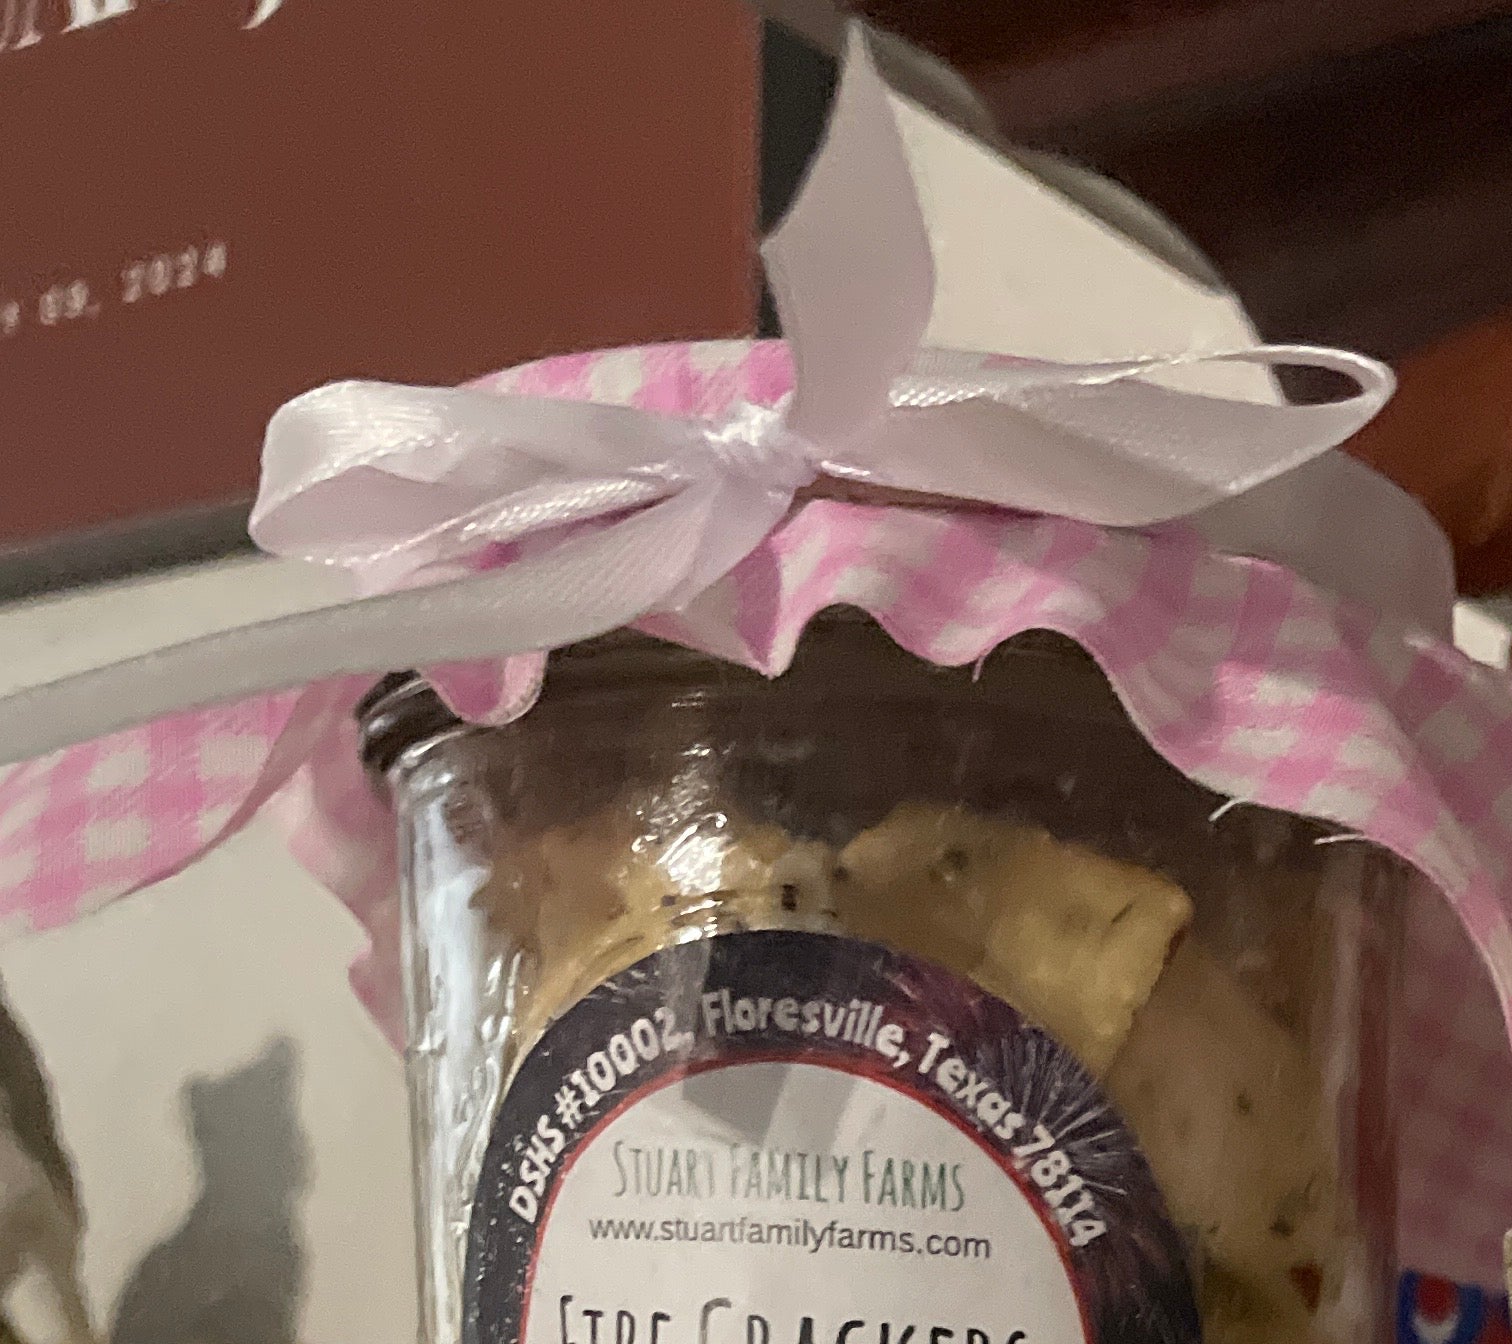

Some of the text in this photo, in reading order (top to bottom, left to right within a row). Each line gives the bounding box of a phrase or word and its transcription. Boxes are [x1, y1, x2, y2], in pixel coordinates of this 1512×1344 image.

[508, 1114, 566, 1223] DSHS
[701, 987, 911, 1069] Floresville,
[916, 1031, 1025, 1140] Texas
[1012, 1124, 1107, 1247] 78114
[729, 1143, 850, 1203] FAMILY
[861, 1149, 966, 1212] FARMS
[588, 1216, 992, 1260] www.stuartfamilyfarms.com
